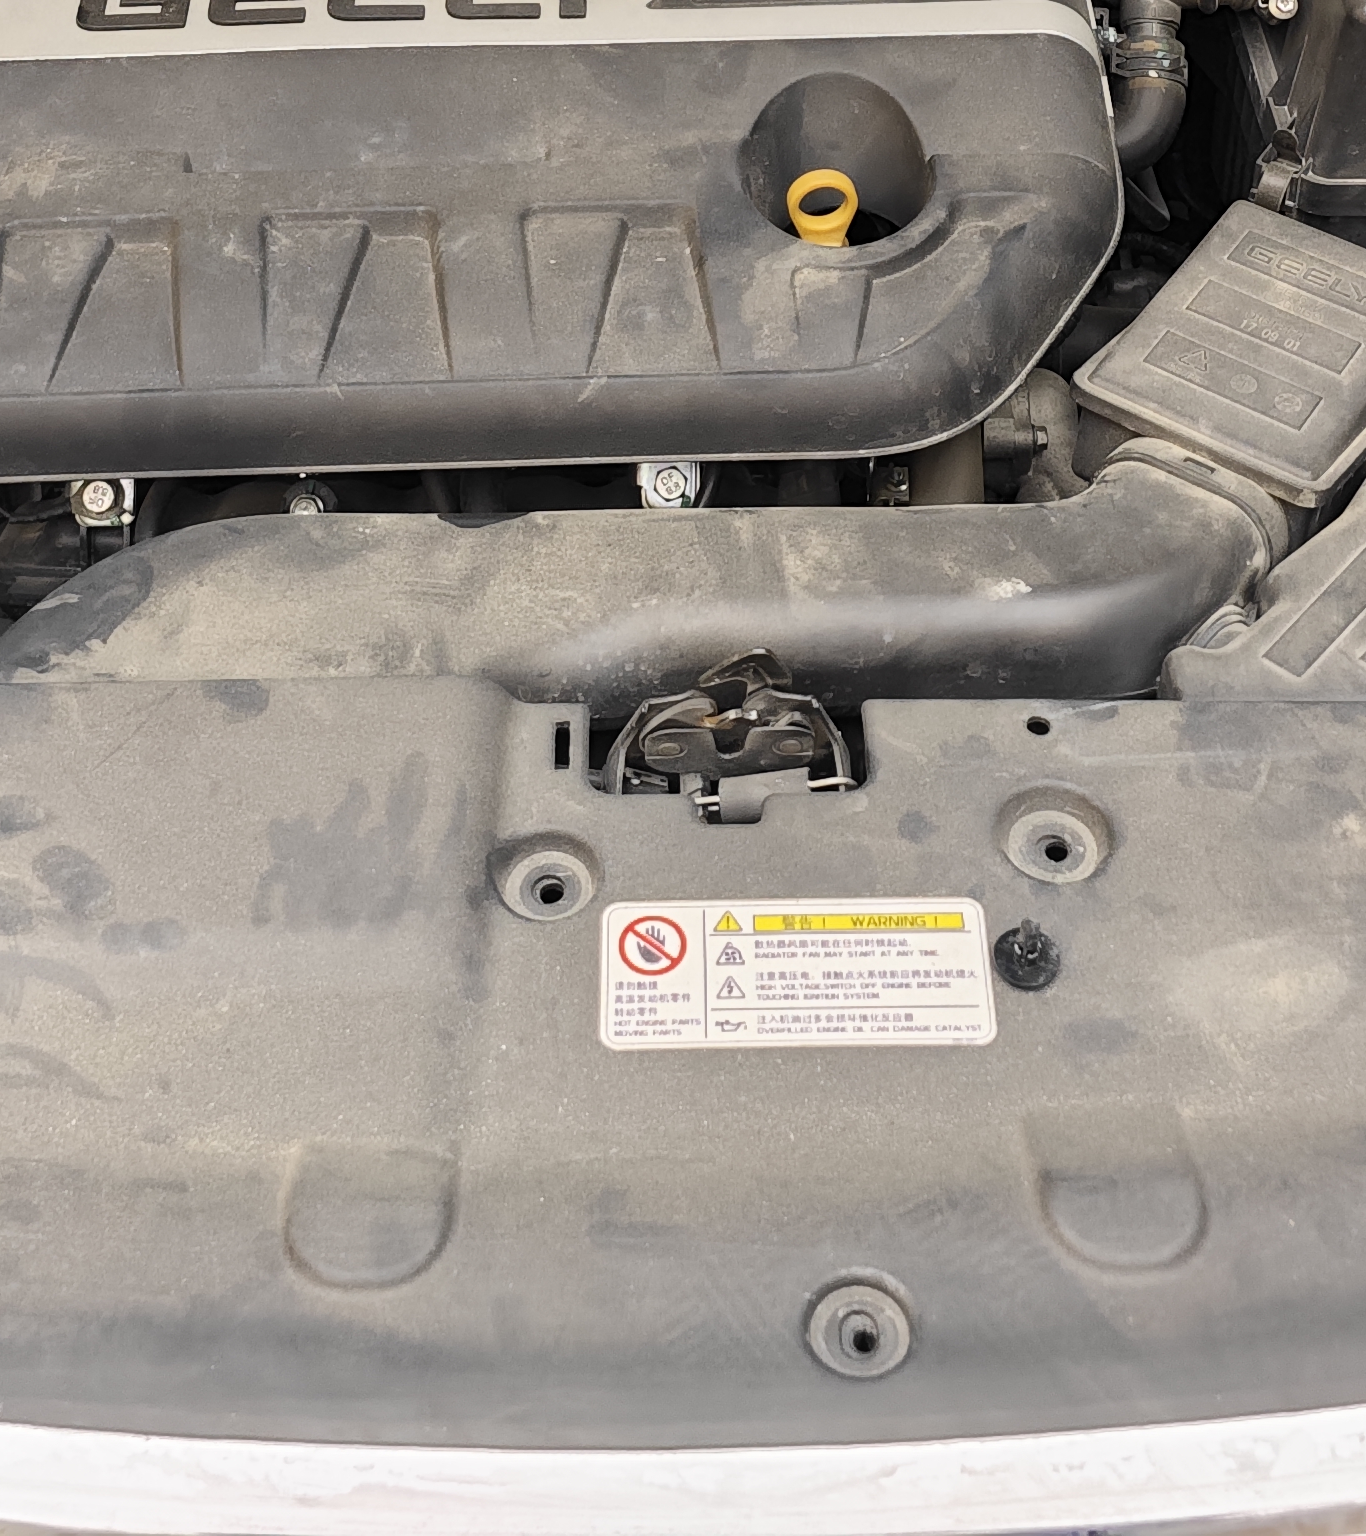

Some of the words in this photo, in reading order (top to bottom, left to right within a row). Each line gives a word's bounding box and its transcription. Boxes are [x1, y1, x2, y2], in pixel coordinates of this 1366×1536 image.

[1239, 319, 1258, 333] 17
[1260, 328, 1280, 343] 09
[755, 951, 799, 959] RADIATOR
[803, 951, 821, 959] FAN
[823, 950, 843, 958] MAY
[847, 950, 876, 958] START
[880, 949, 892, 957] AT
[896, 949, 915, 957] ANY
[755, 983, 777, 991] HIGH
[881, 981, 913, 989] ENGINE
[916, 981, 952, 989] BEFORE
[756, 993, 800, 1001] TOUCHING
[803, 993, 840, 1001] IGNITION
[614, 1019, 632, 1027] HOT
[635, 1019, 668, 1027] ENGINE
[671, 1018, 702, 1026] PARTS
[614, 1029, 649, 1037] MOVING
[652, 1028, 683, 1036] PARTS
[757, 1026, 813, 1034] OVERFILLED
[816, 1026, 849, 1034] ENGINE
[870, 1025, 890, 1033] CAN
[892, 1025, 932, 1033] DAMAGE
[935, 1024, 982, 1032] CATALYST
